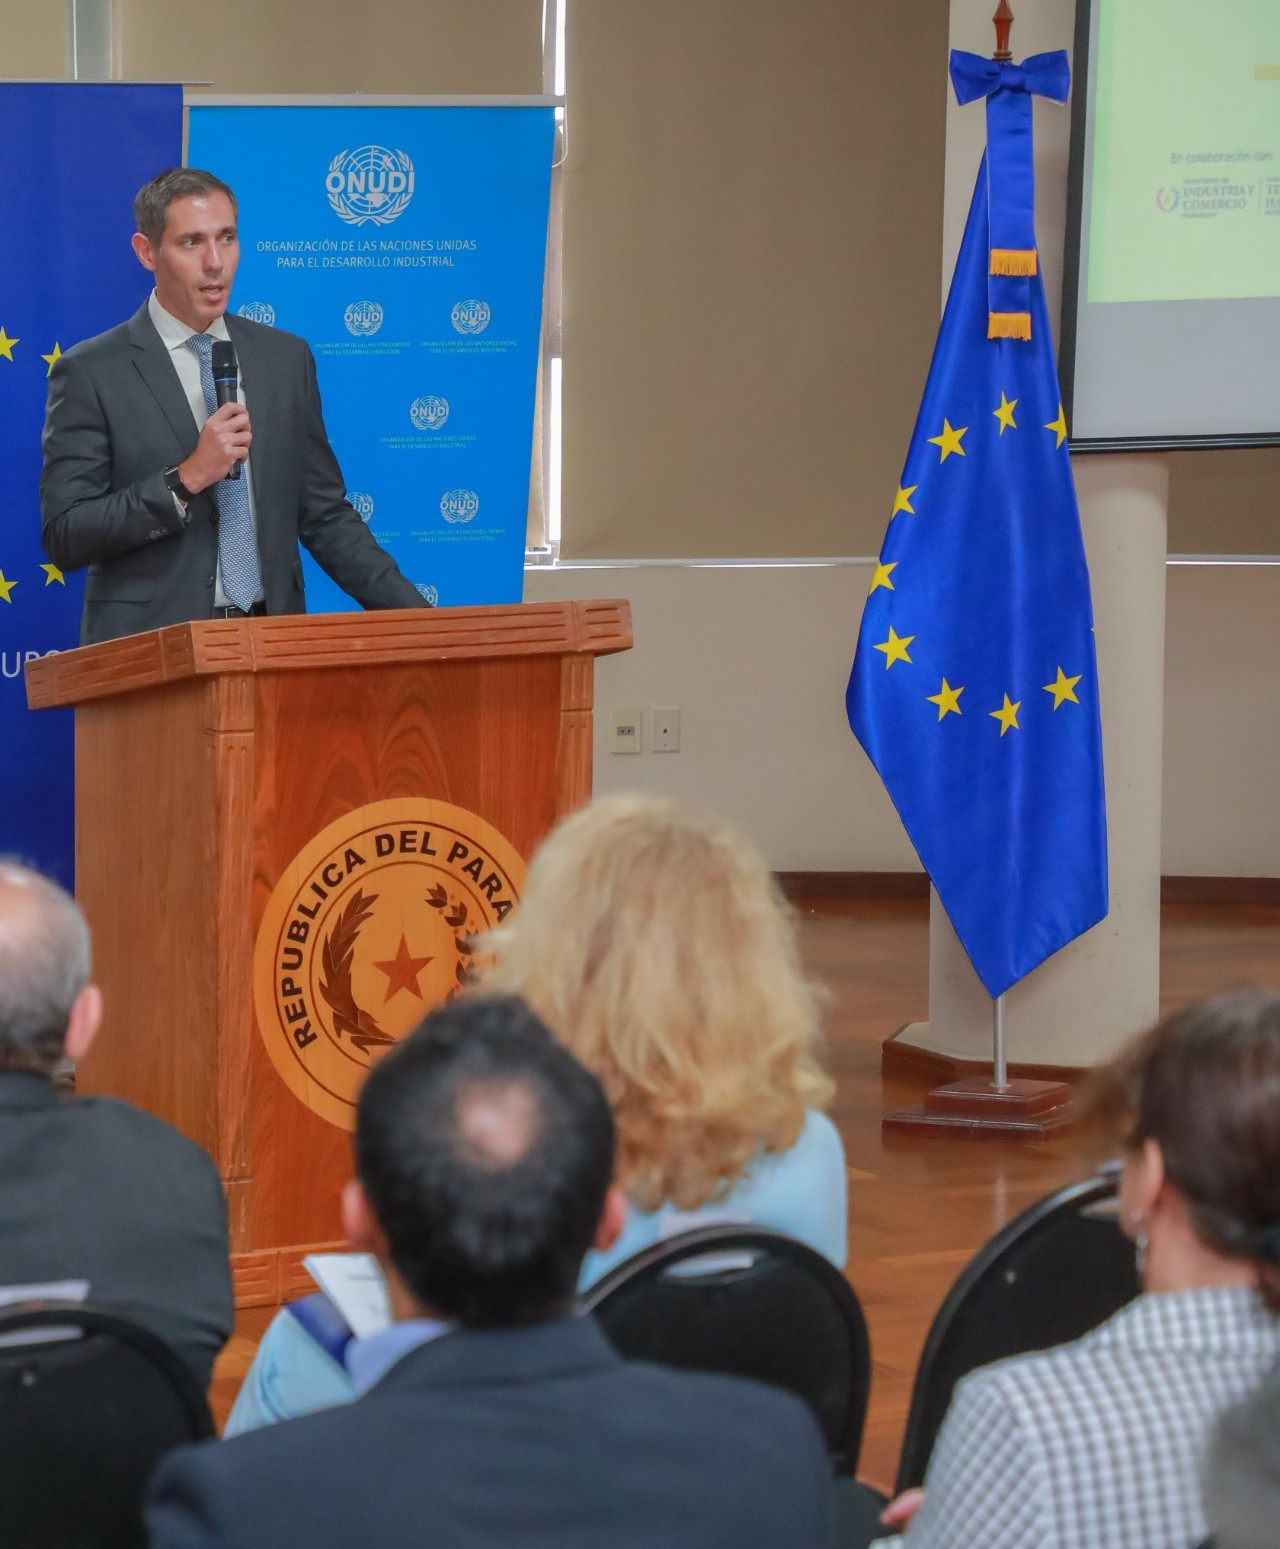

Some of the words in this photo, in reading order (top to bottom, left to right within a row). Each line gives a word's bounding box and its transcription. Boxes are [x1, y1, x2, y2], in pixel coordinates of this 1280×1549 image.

[325, 171, 415, 194] ONUDI
[256, 238, 338, 252] ORGANIZACIÓN
[341, 241, 354, 252] DE
[357, 241, 377, 252] LAS
[380, 240, 434, 252] NACIONES
[436, 240, 477, 250] UNIDAS
[277, 257, 305, 268] PARA
[307, 258, 320, 268] EL
[322, 256, 391, 268] DESARROLLO
[393, 256, 454, 267] INDUSTRIAL
[238, 313, 275, 324] NUDI
[344, 312, 384, 323] ONUDI
[450, 310, 490, 322] ONUDI
[410, 406, 450, 417] ONUDI
[440, 500, 479, 511] ONUDI
[281, 848, 366, 1050] REPUBLICA
[374, 830, 437, 858] DEL
[446, 840, 514, 924] PARA
